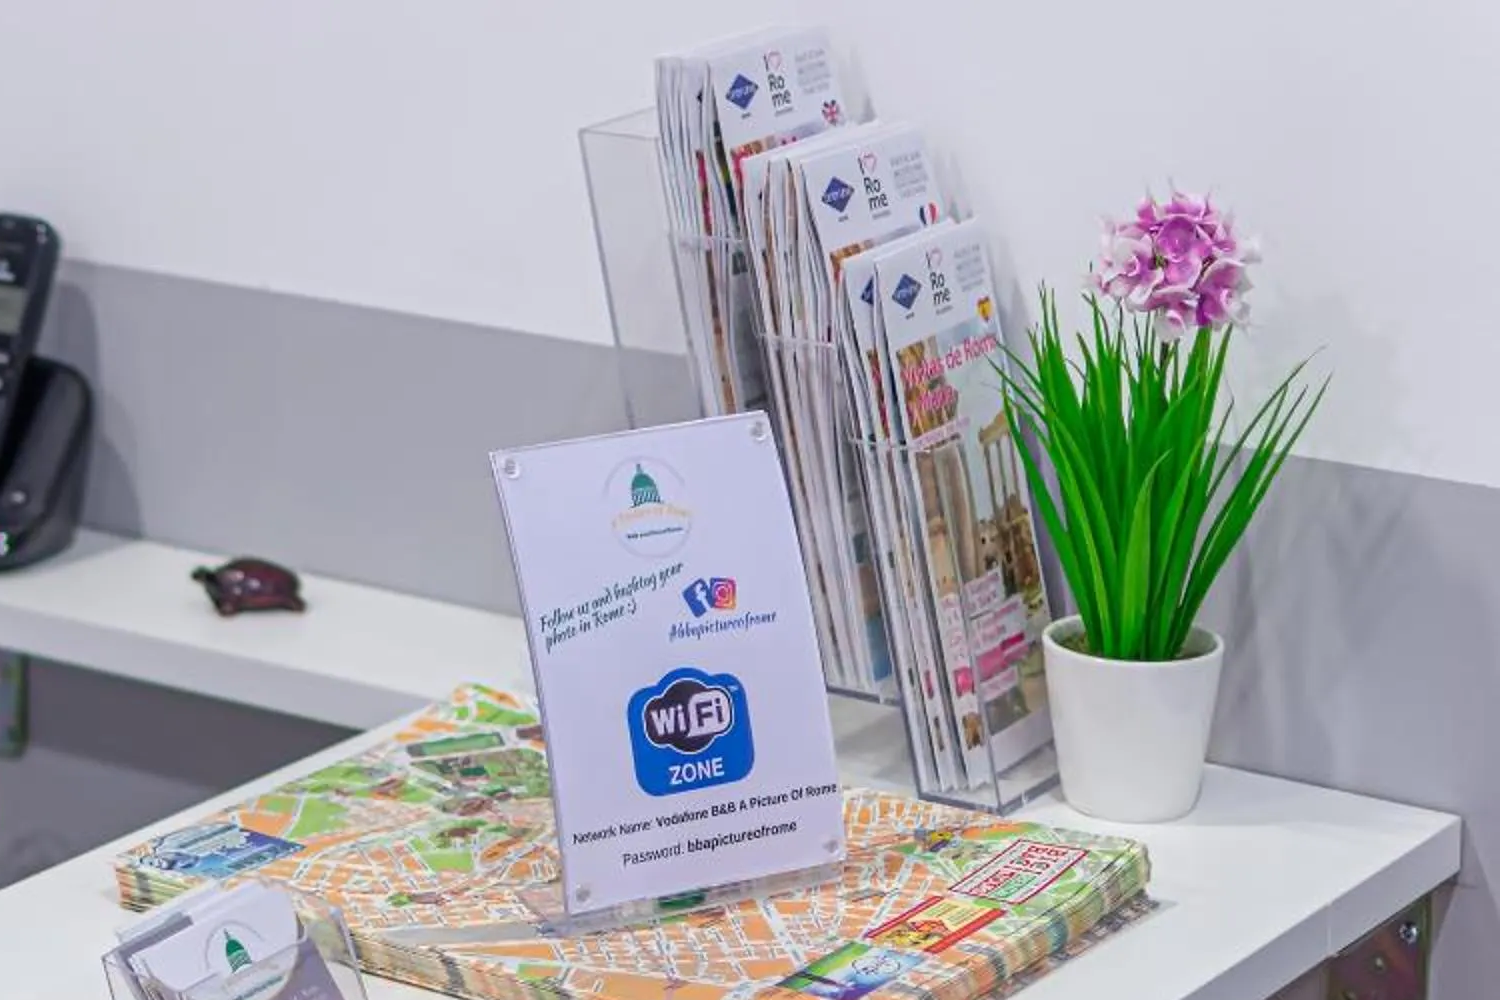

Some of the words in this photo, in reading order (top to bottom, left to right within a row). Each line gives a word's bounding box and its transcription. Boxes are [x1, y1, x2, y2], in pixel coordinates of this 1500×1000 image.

[863, 177, 881, 194] Ro
[868, 193, 889, 210] me
[945, 346, 962, 369] de
[540, 607, 575, 633] Follow
[592, 587, 613, 609] and
[580, 619, 591, 632] in
[669, 757, 725, 785] ZONE
[573, 825, 617, 844] Network
[656, 808, 709, 827] Vodafone
[711, 801, 737, 817] B&B
[739, 799, 748, 812] A
[749, 791, 789, 809] Picture
[805, 783, 837, 797] Rome
[687, 821, 798, 853] bbapictureofrome
